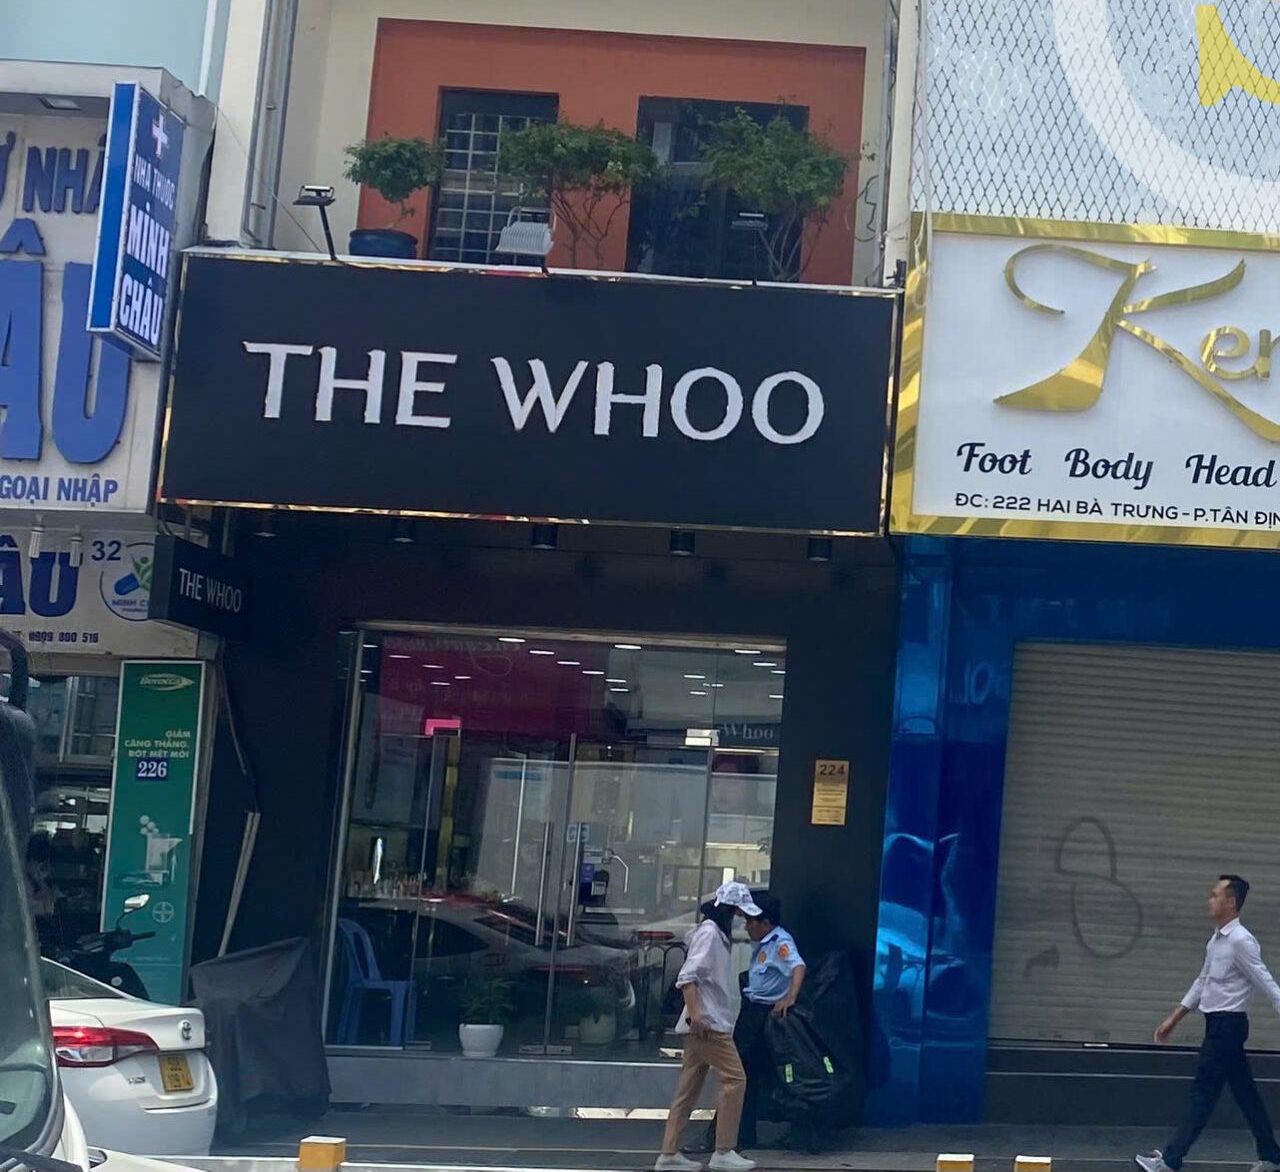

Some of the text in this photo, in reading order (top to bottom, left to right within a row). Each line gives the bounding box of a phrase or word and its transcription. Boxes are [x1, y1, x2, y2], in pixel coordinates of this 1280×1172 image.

[243, 339, 824, 444] THE WHOO
[956, 441, 1032, 476] Foot
[1064, 448, 1154, 490] Body
[1185, 454, 1277, 488] Head
[57, 473, 118, 507] NHẬP
[1037, 498, 1071, 514] HAI
[1076, 497, 1103, 516] BÀ
[91, 540, 121, 561] 32
[179, 568, 242, 613] THE WHOO
[138, 760, 167, 778] 226
[820, 764, 845, 776] 224
